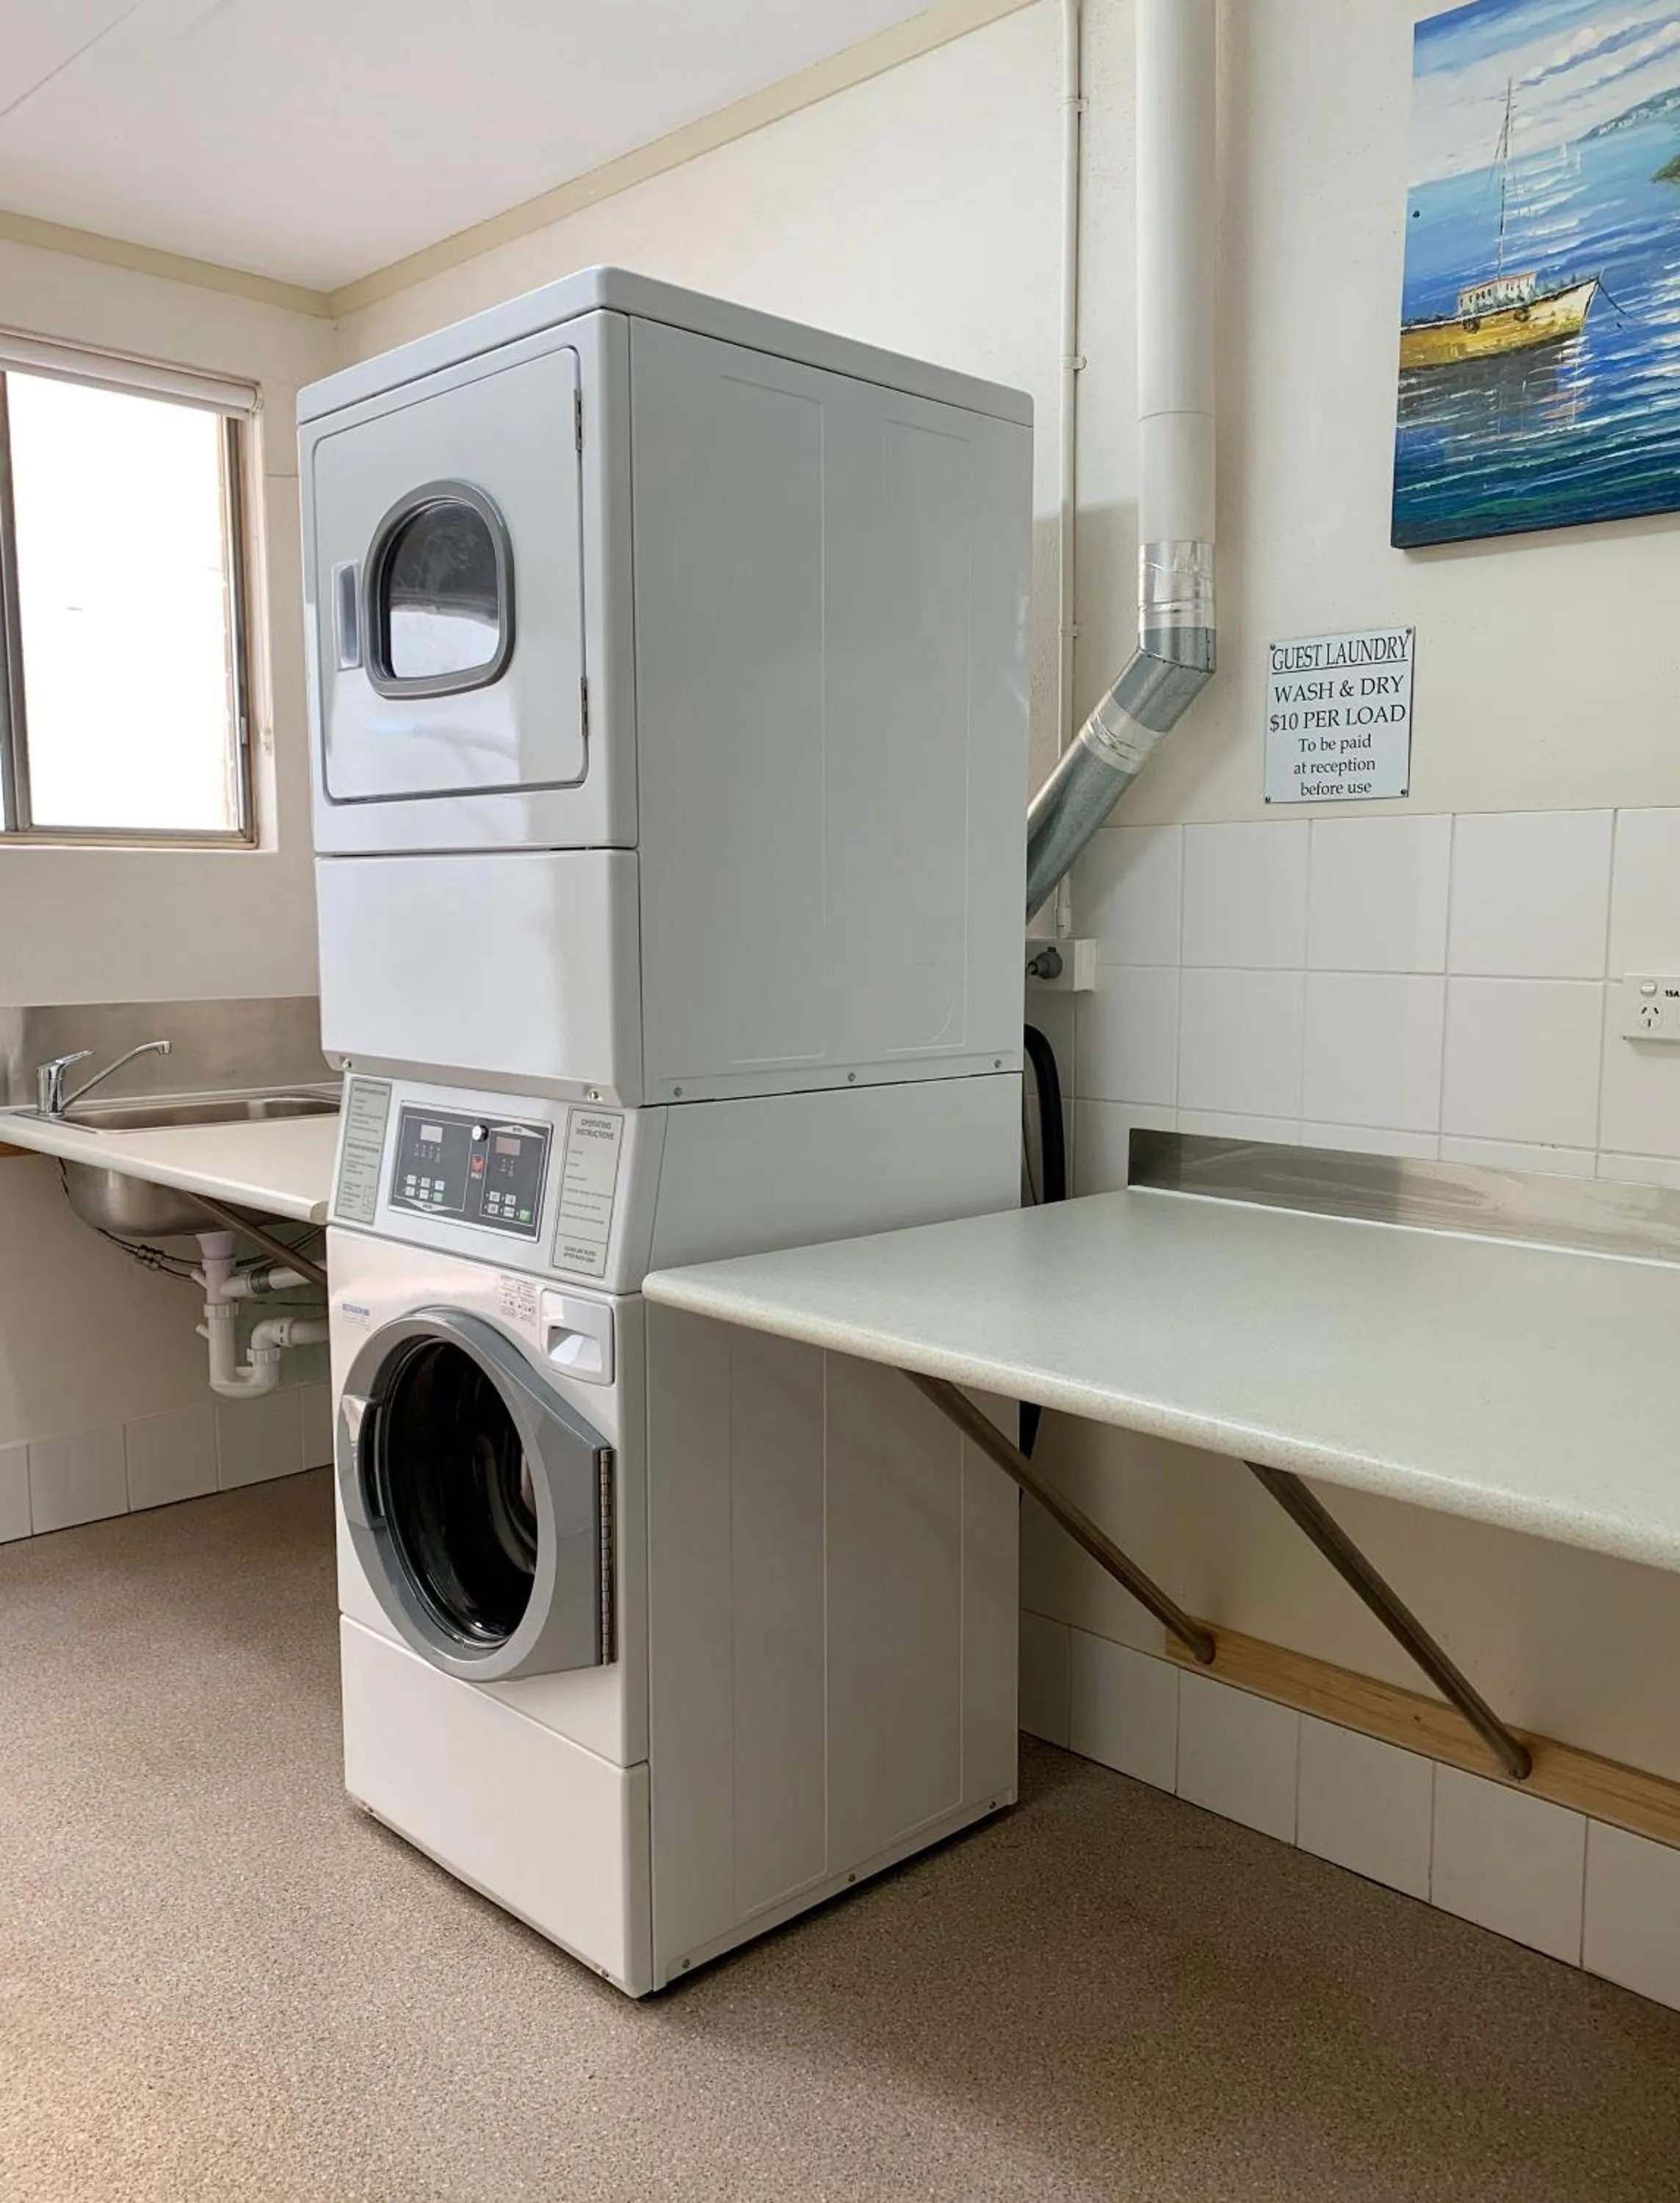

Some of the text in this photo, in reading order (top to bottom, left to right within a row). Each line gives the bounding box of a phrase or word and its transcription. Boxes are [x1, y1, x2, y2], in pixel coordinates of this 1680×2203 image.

[1272, 635, 1410, 671] GUEST LAUNDRY
[1275, 675, 1404, 703] WASH & DRY
[1270, 704, 1406, 733] $10 PER LOAD
[1298, 734, 1372, 753] To be paid
[1294, 758, 1375, 775] at reception
[1300, 781, 1372, 796] before use
